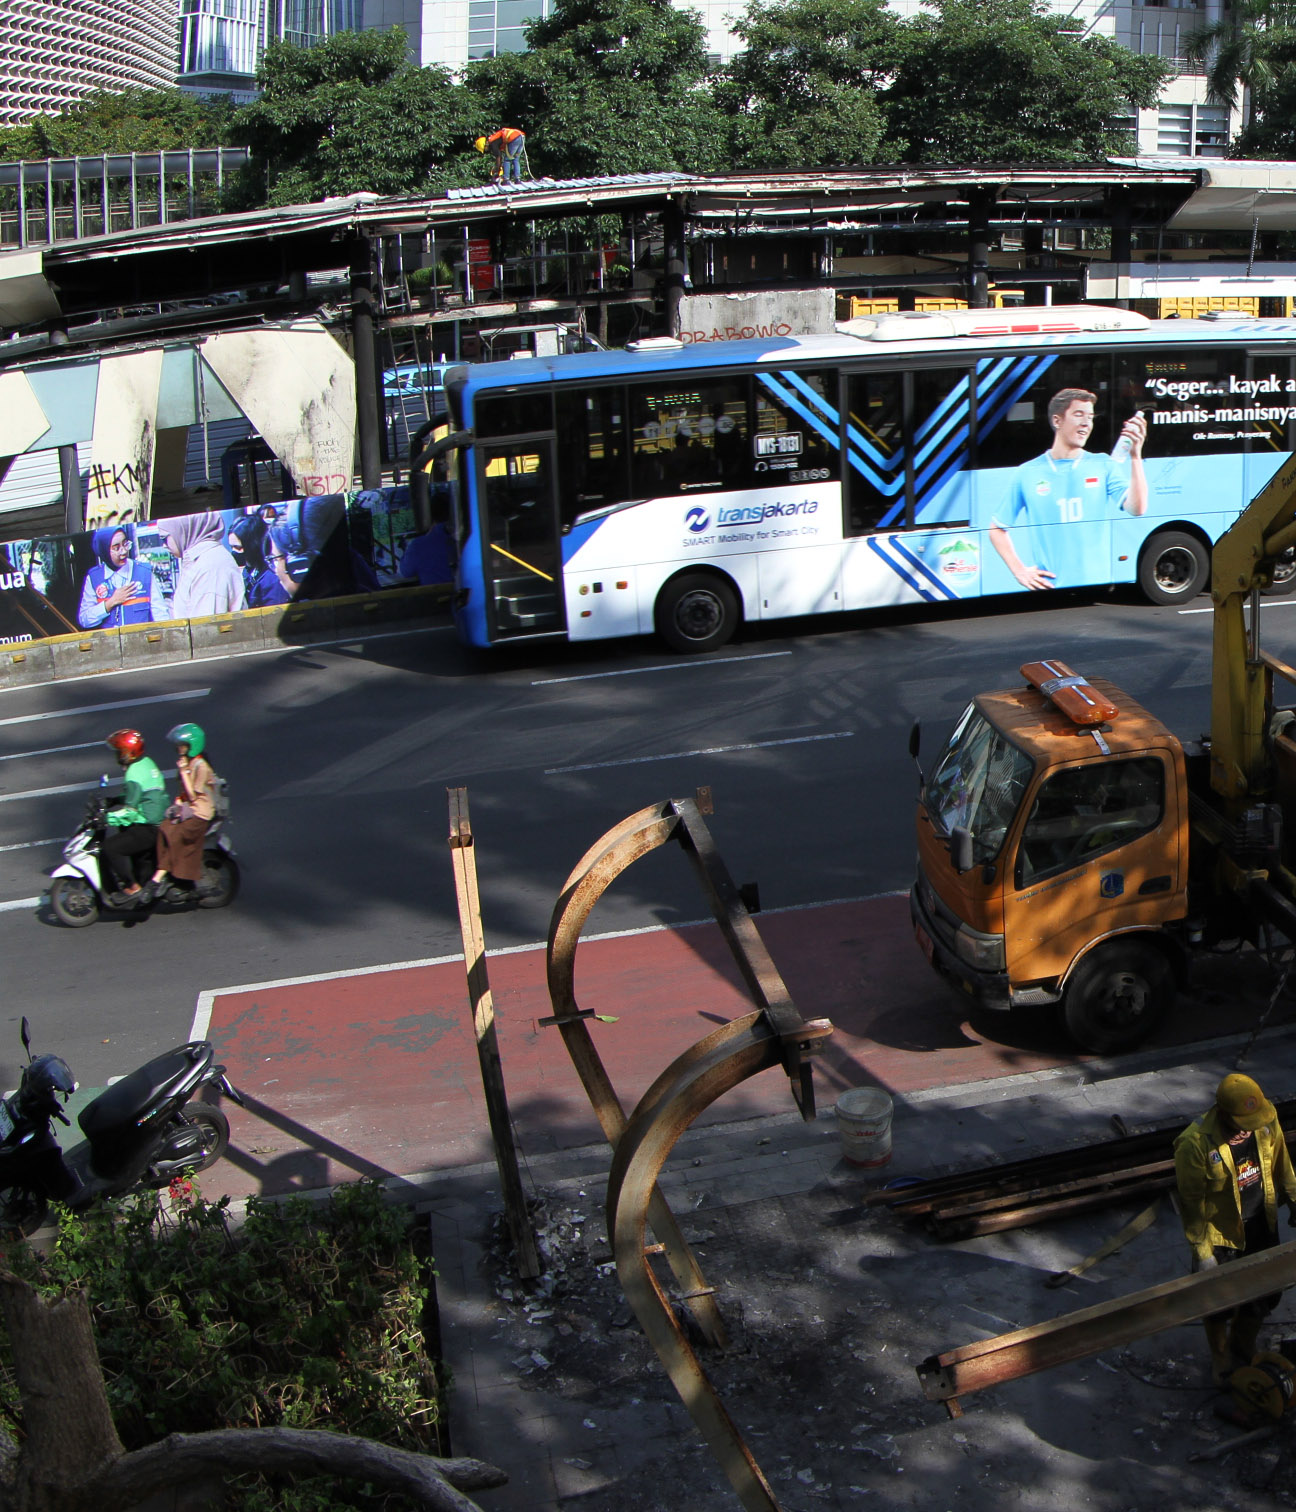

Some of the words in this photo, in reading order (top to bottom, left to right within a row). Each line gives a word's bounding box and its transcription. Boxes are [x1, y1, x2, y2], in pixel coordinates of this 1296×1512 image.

[1229, 374, 1281, 399] kayak
[717, 499, 819, 527] transjakarta
[1056, 497, 1083, 524] 10
[682, 535, 716, 547] SMART
[717, 531, 755, 544] Mobility
[756, 530, 770, 541] for
[771, 528, 799, 539] Smart
[800, 525, 820, 536] City
